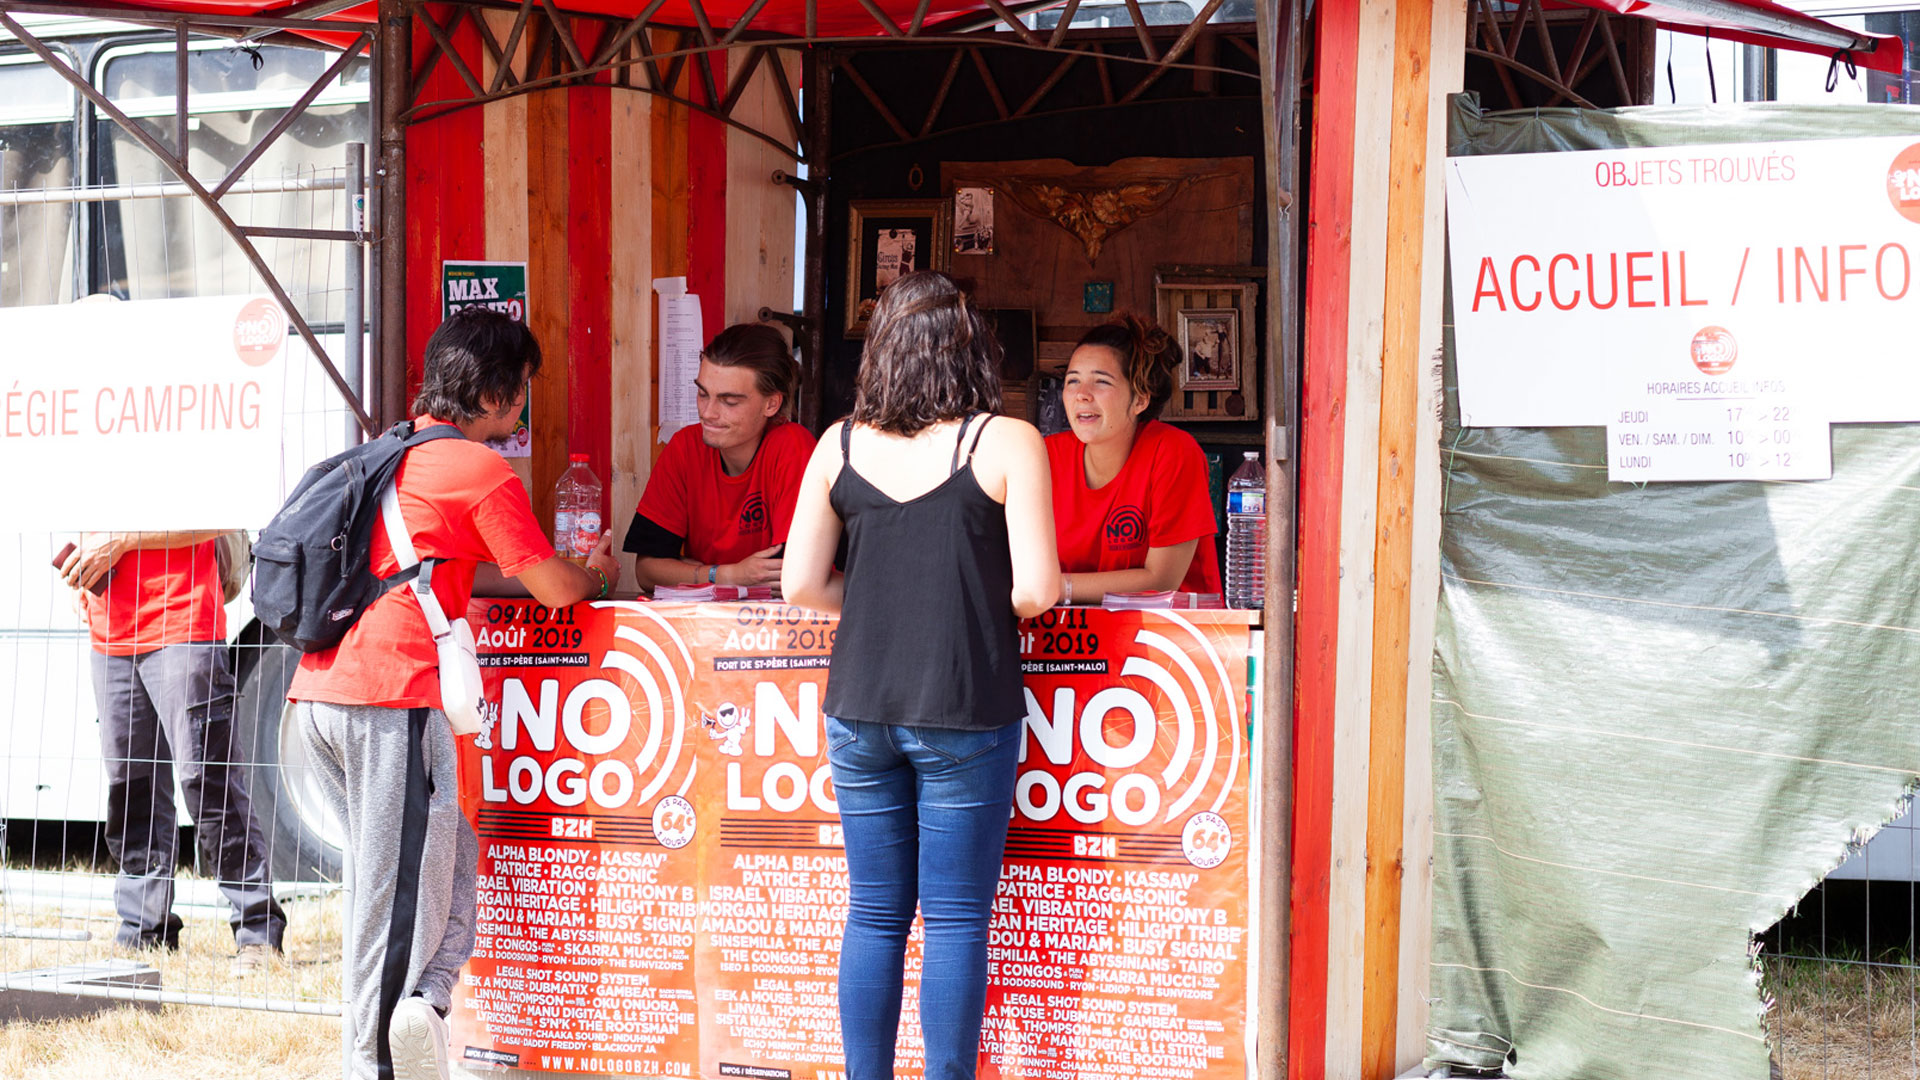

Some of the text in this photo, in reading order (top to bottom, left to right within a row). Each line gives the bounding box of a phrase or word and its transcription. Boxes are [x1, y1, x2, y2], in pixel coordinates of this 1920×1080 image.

[1596, 150, 1796, 187] OBJETS TROUVÉS
[1472, 242, 1910, 312] ACCUEIL / INFO
[448, 277, 500, 302] MAX
[1648, 381, 1701, 394] HORAIRES
[1703, 381, 1749, 394] ACCUEIL
[4, 379, 261, 438] ÉGIE CAMPING
[1618, 411, 1648, 424] JEUDI
[1619, 433, 1643, 446] VEN.
[1653, 433, 1680, 446] SAM.
[1690, 433, 1714, 446] DIM.
[1620, 456, 1652, 468] LUNDI
[741, 508, 763, 522] NO
[1107, 523, 1132, 538] NO
[487, 604, 575, 625] 09/10/11
[476, 624, 582, 649] Août 2019
[724, 626, 780, 650] Août
[1043, 632, 1098, 655] 2019
[490, 654, 588, 666] DE ST-PÈRE (SAINT-MALO)
[717, 656, 788, 670] FORT DE ST-PÈRE
[1046, 662, 1106, 673] (SAINT-MALO)
[500, 678, 632, 755] NO
[755, 682, 827, 758] N
[1018, 686, 1156, 768] NO
[481, 755, 634, 809] LOGO
[727, 762, 842, 814] LOG
[1010, 770, 1160, 826] OGO
[552, 817, 592, 838] BZH
[487, 844, 591, 864] ALPHA BLONDY
[1074, 836, 1116, 858] BZH
[494, 860, 658, 884] PATRICE RAGGASONIC
[733, 854, 790, 870] ALPHA
[742, 870, 810, 888] PATRICE
[1046, 866, 1114, 885] BLONDY
[511, 877, 678, 900] VIBRATION ANTHONY
[710, 885, 766, 902] ISRAEL
[996, 880, 1188, 906] PATRICE RAGGASONIC
[514, 893, 654, 915] HERITAGE HILIGHT
[700, 900, 768, 918] MORGAN
[1022, 898, 1228, 925] VIBRATION ANTHONY B
[526, 910, 640, 930] MARIAM BUSY
[701, 918, 771, 935] AMADOU
[1026, 915, 1241, 943] HERITAGE HILIGHT TRIBE
[551, 928, 692, 948] ABYSSINIANS TAIRO
[710, 934, 785, 950] SINSEMILIA
[792, 938, 821, 951] THE
[1044, 933, 1238, 960] MARIAM BUSY SIGNAL
[495, 938, 538, 952] CONGOS
[564, 944, 620, 957] SKARRA
[623, 946, 667, 960] MUCCI
[721, 949, 748, 962] THE
[752, 950, 808, 964] CONGOS
[542, 955, 604, 966] RYON LIDIOP
[1048, 950, 1224, 974] THE ABYSSINIANS TAIRO
[496, 966, 649, 986] LEGAL SHOT SOUND SYSTEM
[754, 978, 792, 991] LEGAL
[794, 980, 826, 993] SHOT
[1002, 963, 1062, 978] CONGOS
[1092, 968, 1148, 986] SKARRA
[1150, 972, 1196, 988] MUCCI
[493, 977, 524, 990] MOUSE
[529, 982, 588, 996] DUBMATIX
[596, 985, 657, 999] GAMBEAT
[751, 990, 793, 1004] MOUSE
[1002, 978, 1214, 1000] DODOSOUND RYON LIDIOP SUNVIZORS
[474, 988, 508, 1001] LINVAL
[510, 990, 564, 1006] THOMPSON
[592, 998, 620, 1010] OKU
[622, 999, 679, 1012] ONUORA
[493, 1000, 610, 1020] NANCY MANU DIGITAL
[1003, 992, 1178, 1017] LEGAL SHOT SOUND SYSTEM
[728, 1002, 836, 1020] LINVAL THOMPSON
[1000, 1006, 1046, 1020] MOUSE
[1052, 1010, 1116, 1026] DUBMATIX
[1123, 1014, 1186, 1030] GAMBEAT
[580, 1020, 678, 1034] THE ROOTSMAN
[750, 1015, 833, 1030] NANCY MANU
[1022, 1020, 1092, 1036] THOMPSON
[1119, 1026, 1148, 1040] OKU
[1150, 1030, 1208, 1044] ONUORA
[999, 1030, 1043, 1044] NANCY
[1050, 1034, 1087, 1048] MANU
[1091, 1038, 1138, 1052] DIGITAL
[1167, 1042, 1224, 1058] STITCHIE
[541, 1055, 690, 1076] WWW.NOLOGOBZH.COM
[990, 1054, 1136, 1074] ECHO CHAAKA SOUND
[1104, 1051, 1208, 1070] THE ROOTSMAN
